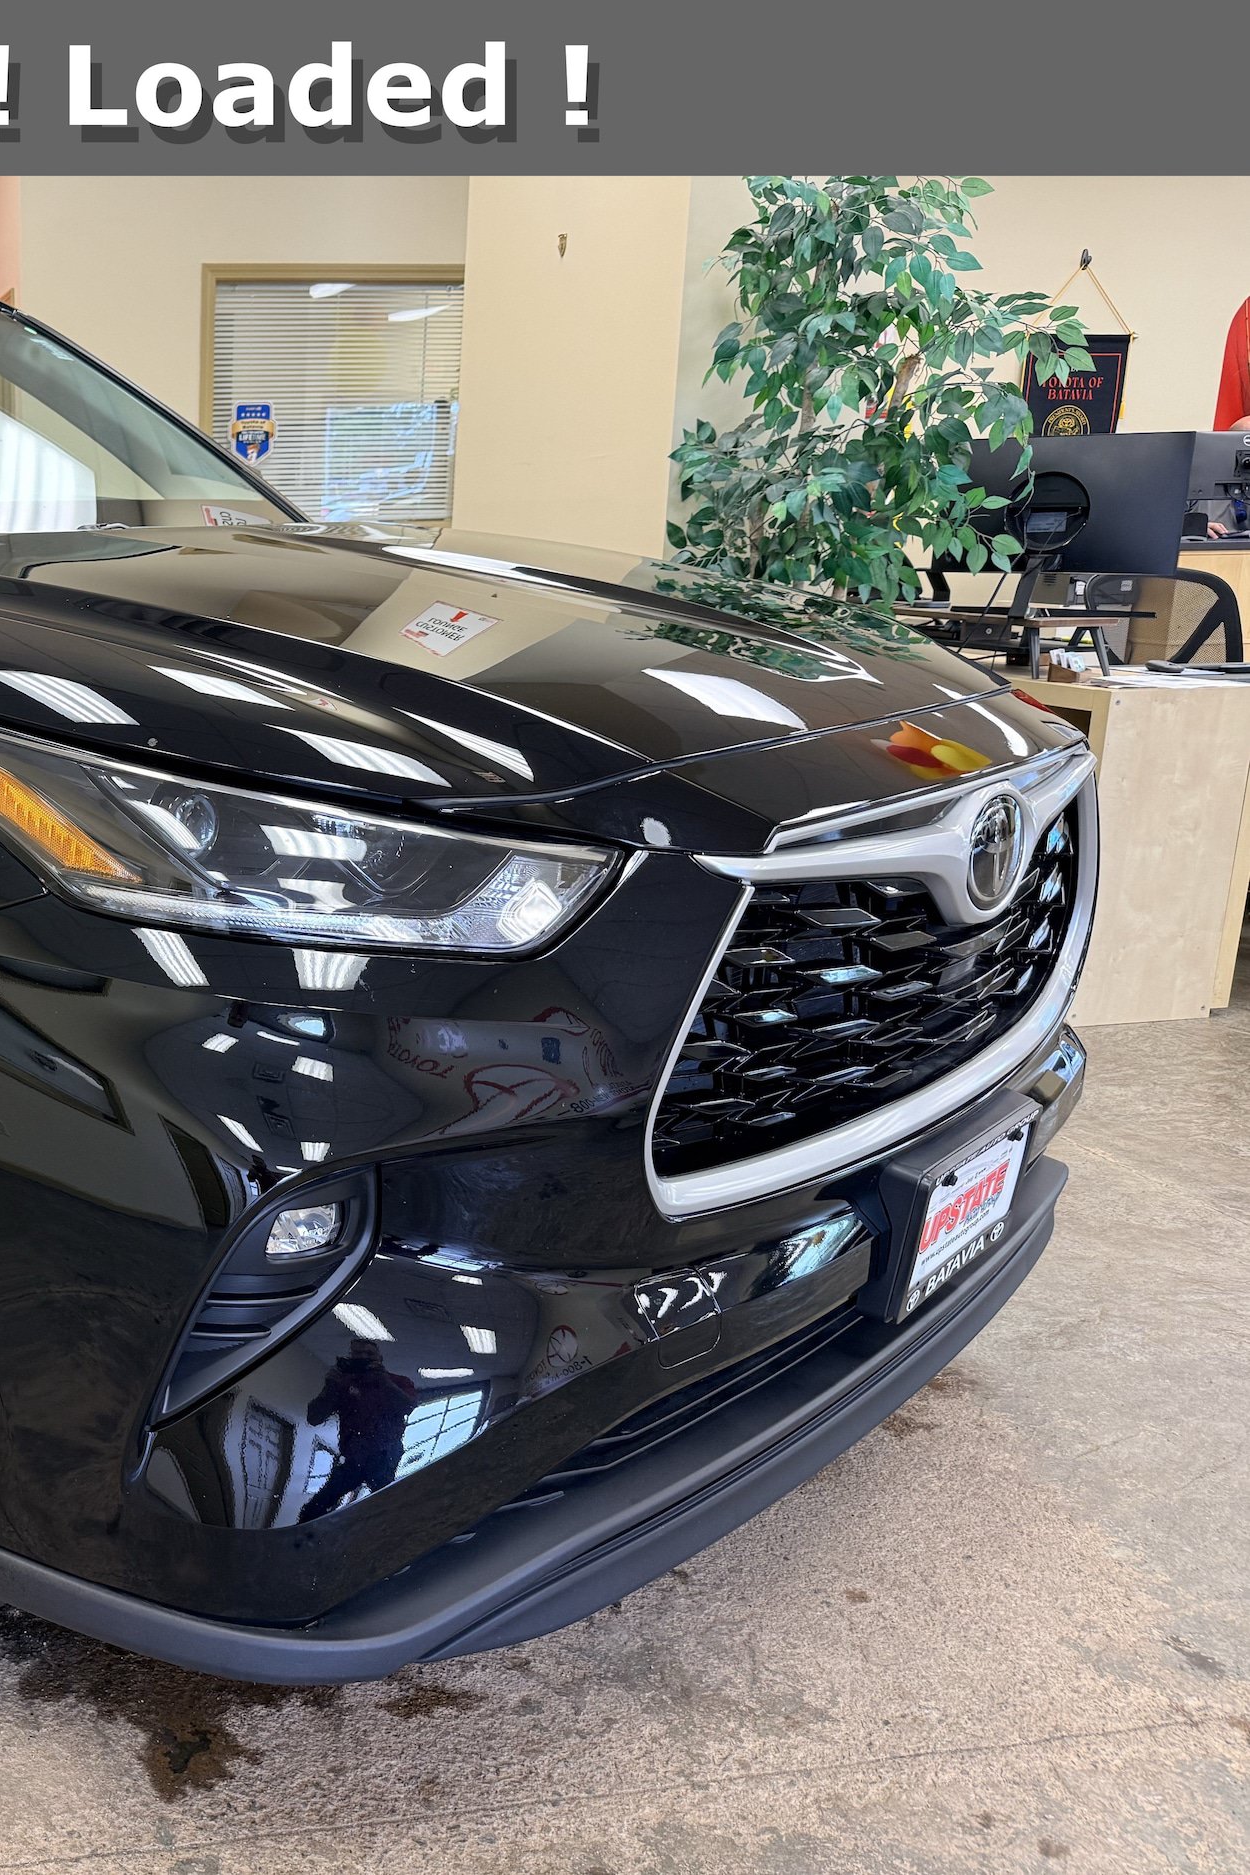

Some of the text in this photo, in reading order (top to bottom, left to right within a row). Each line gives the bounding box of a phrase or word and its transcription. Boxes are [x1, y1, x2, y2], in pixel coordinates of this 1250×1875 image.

[1042, 376, 1104, 388] OOTA OF
[1047, 389, 1093, 400] BATAVIA
[917, 1159, 1011, 1255] UPSTATE
[925, 1235, 986, 1297] BATAVIA
